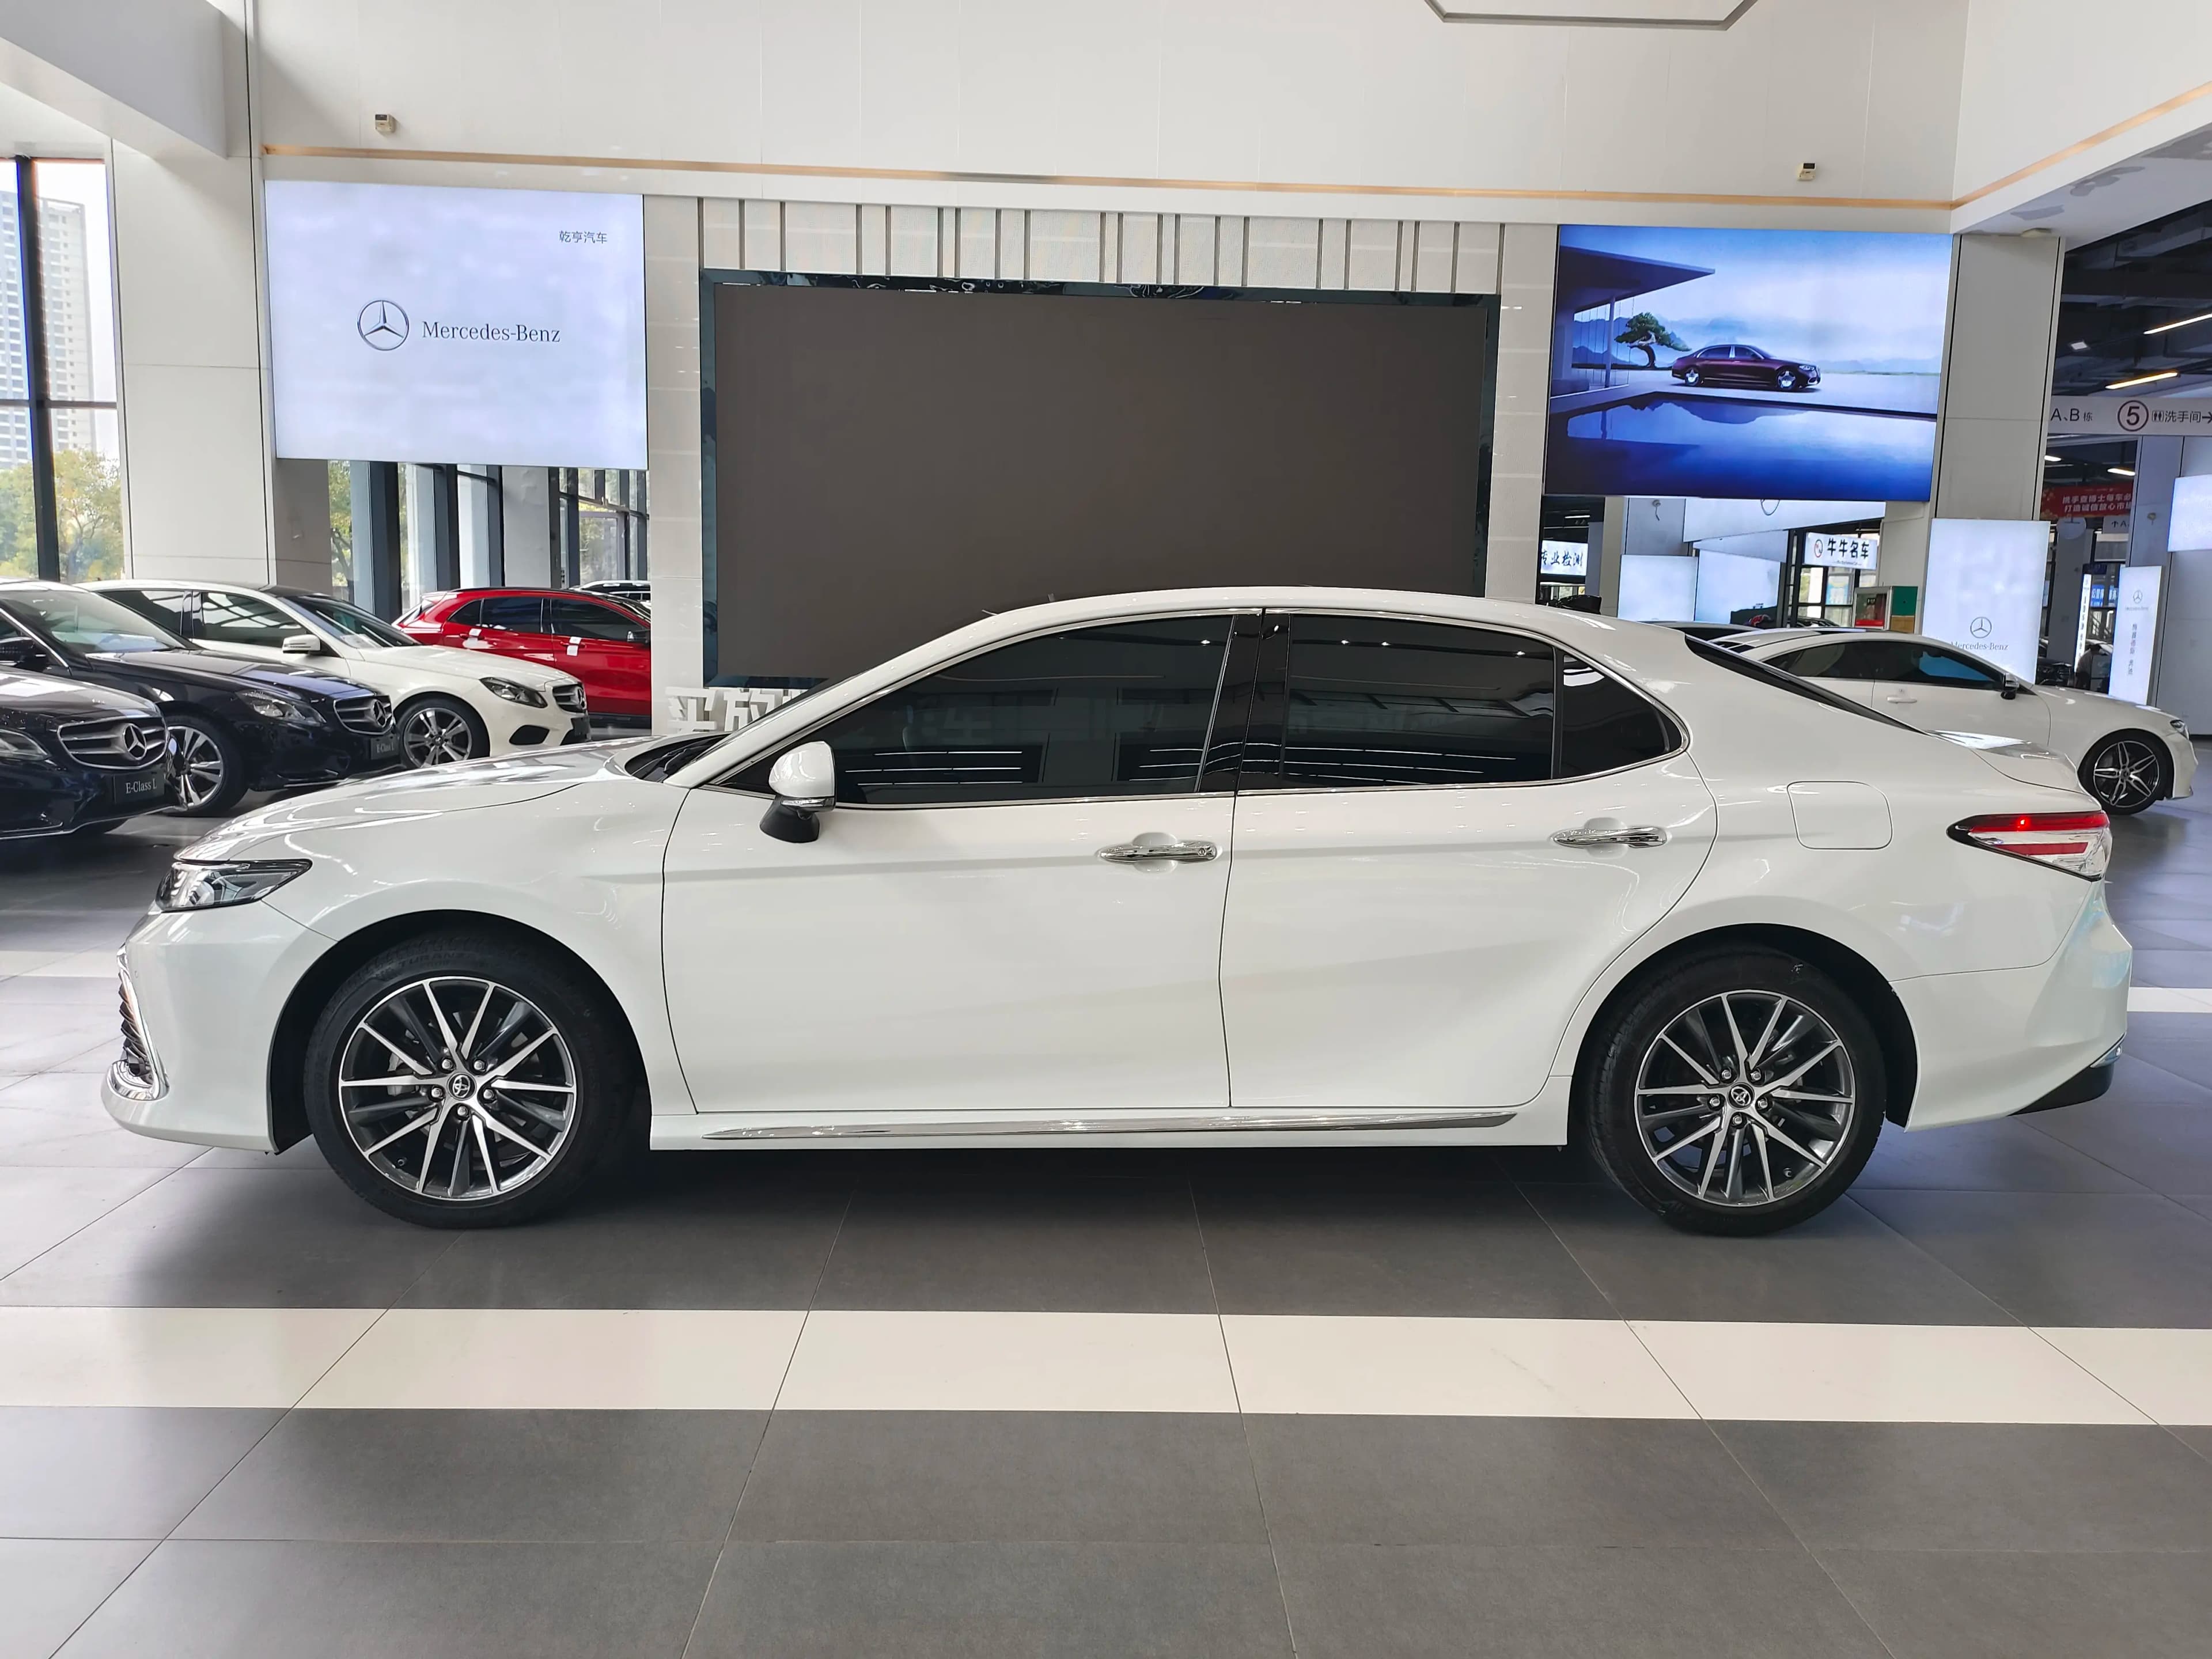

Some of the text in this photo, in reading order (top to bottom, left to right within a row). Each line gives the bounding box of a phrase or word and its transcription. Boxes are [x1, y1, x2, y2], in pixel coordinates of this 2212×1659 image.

[559, 230, 608, 244] 乾亨汽车
[422, 321, 560, 342] Mercedes-Benz
[2165, 410, 2201, 423] 洗手间
[1827, 537, 1869, 559] 牛牛名车
[126, 778, 157, 794] E-Class L
